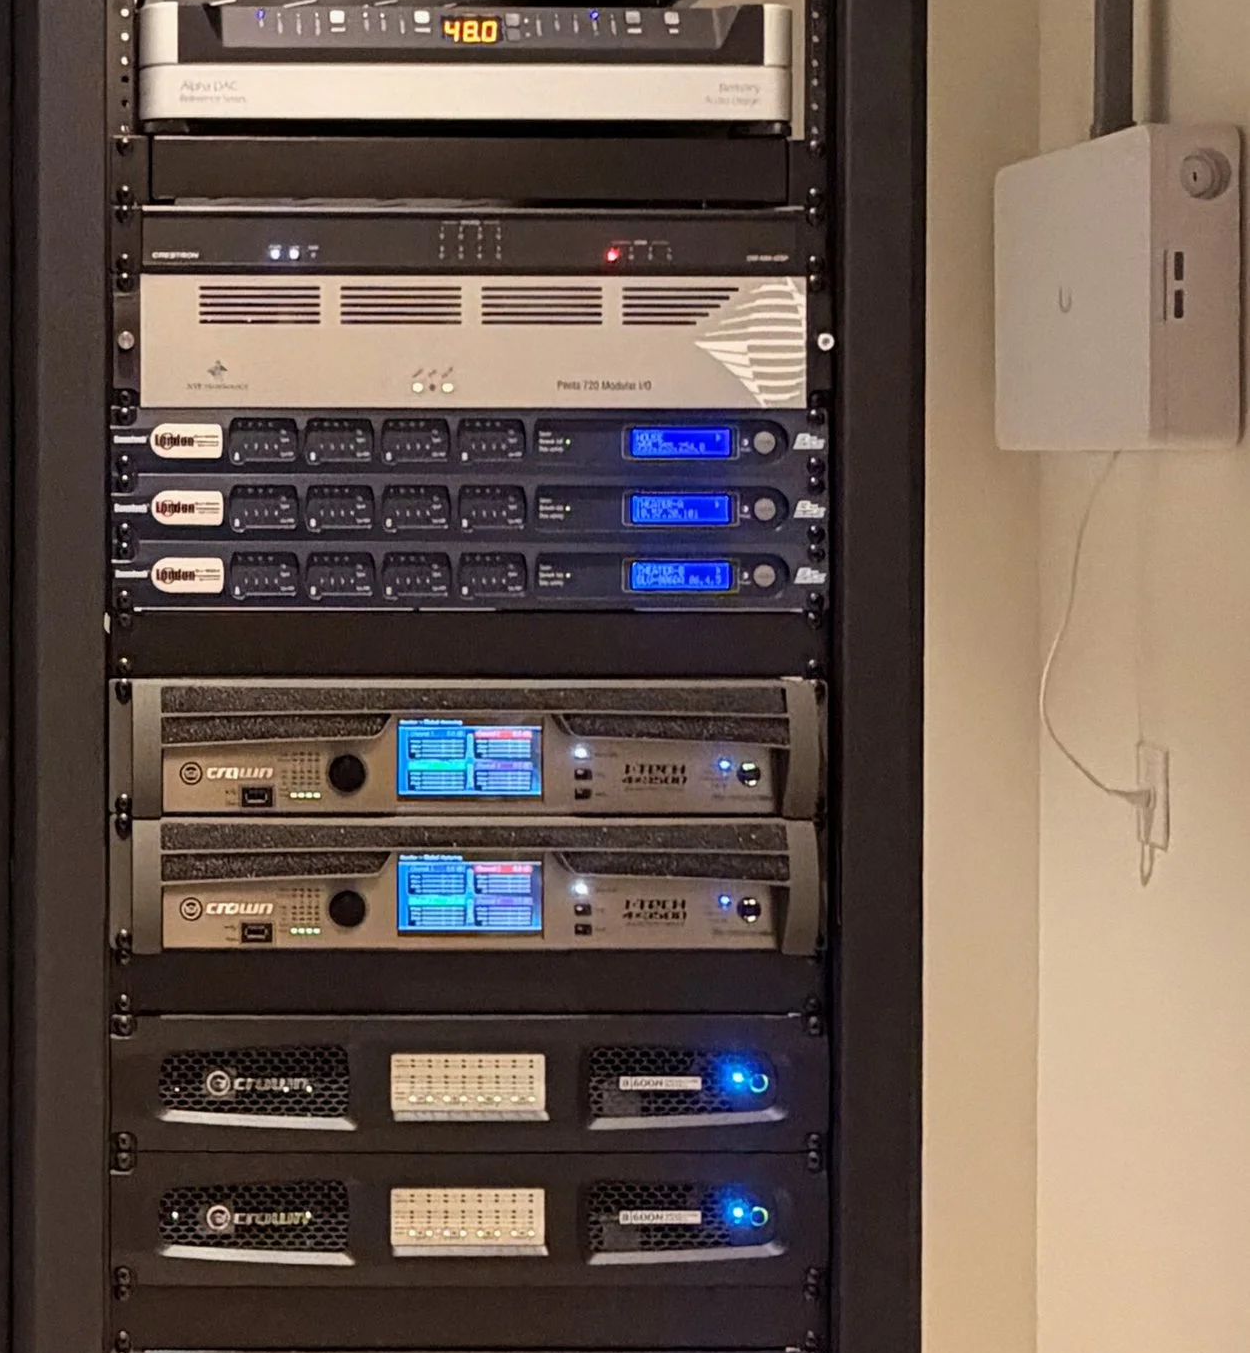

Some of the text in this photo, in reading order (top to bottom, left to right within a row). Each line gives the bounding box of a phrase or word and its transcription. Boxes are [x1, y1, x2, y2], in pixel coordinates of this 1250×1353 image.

[151, 251, 200, 260] CRESTRON
[154, 434, 195, 447] London
[155, 501, 195, 514] London
[155, 568, 196, 582] London
[206, 766, 274, 780] crown
[206, 901, 274, 915] crown
